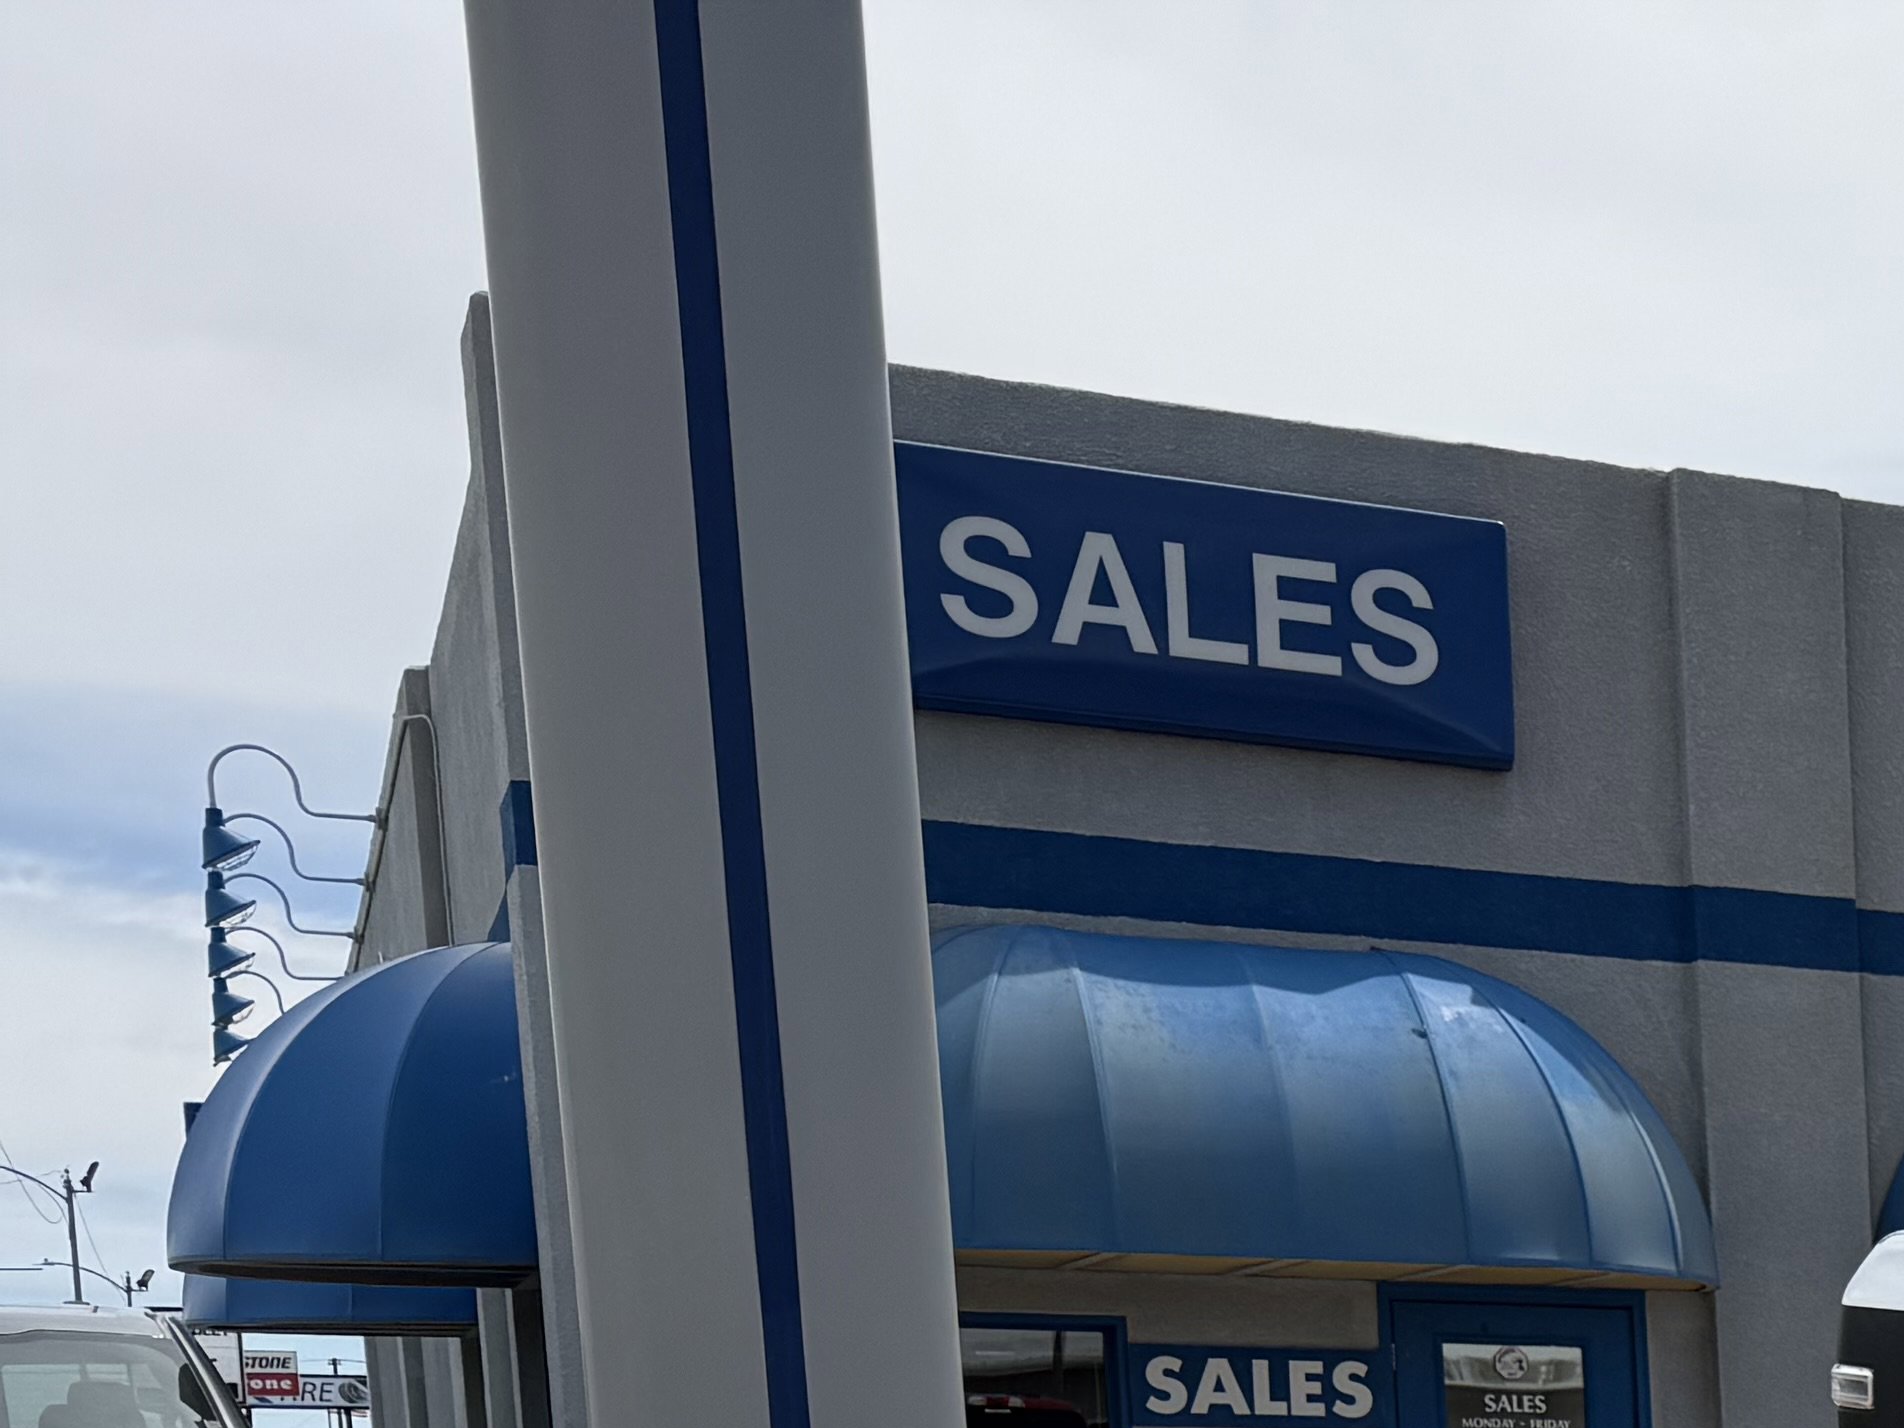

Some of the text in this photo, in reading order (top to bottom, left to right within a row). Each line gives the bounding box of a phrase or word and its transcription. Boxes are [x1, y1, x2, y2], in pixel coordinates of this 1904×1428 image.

[939, 516, 1440, 685] SALES
[1145, 1355, 1374, 1419] SALES
[1484, 1393, 1548, 1413] SALES
[1462, 1417, 1515, 1428] MONDAY
